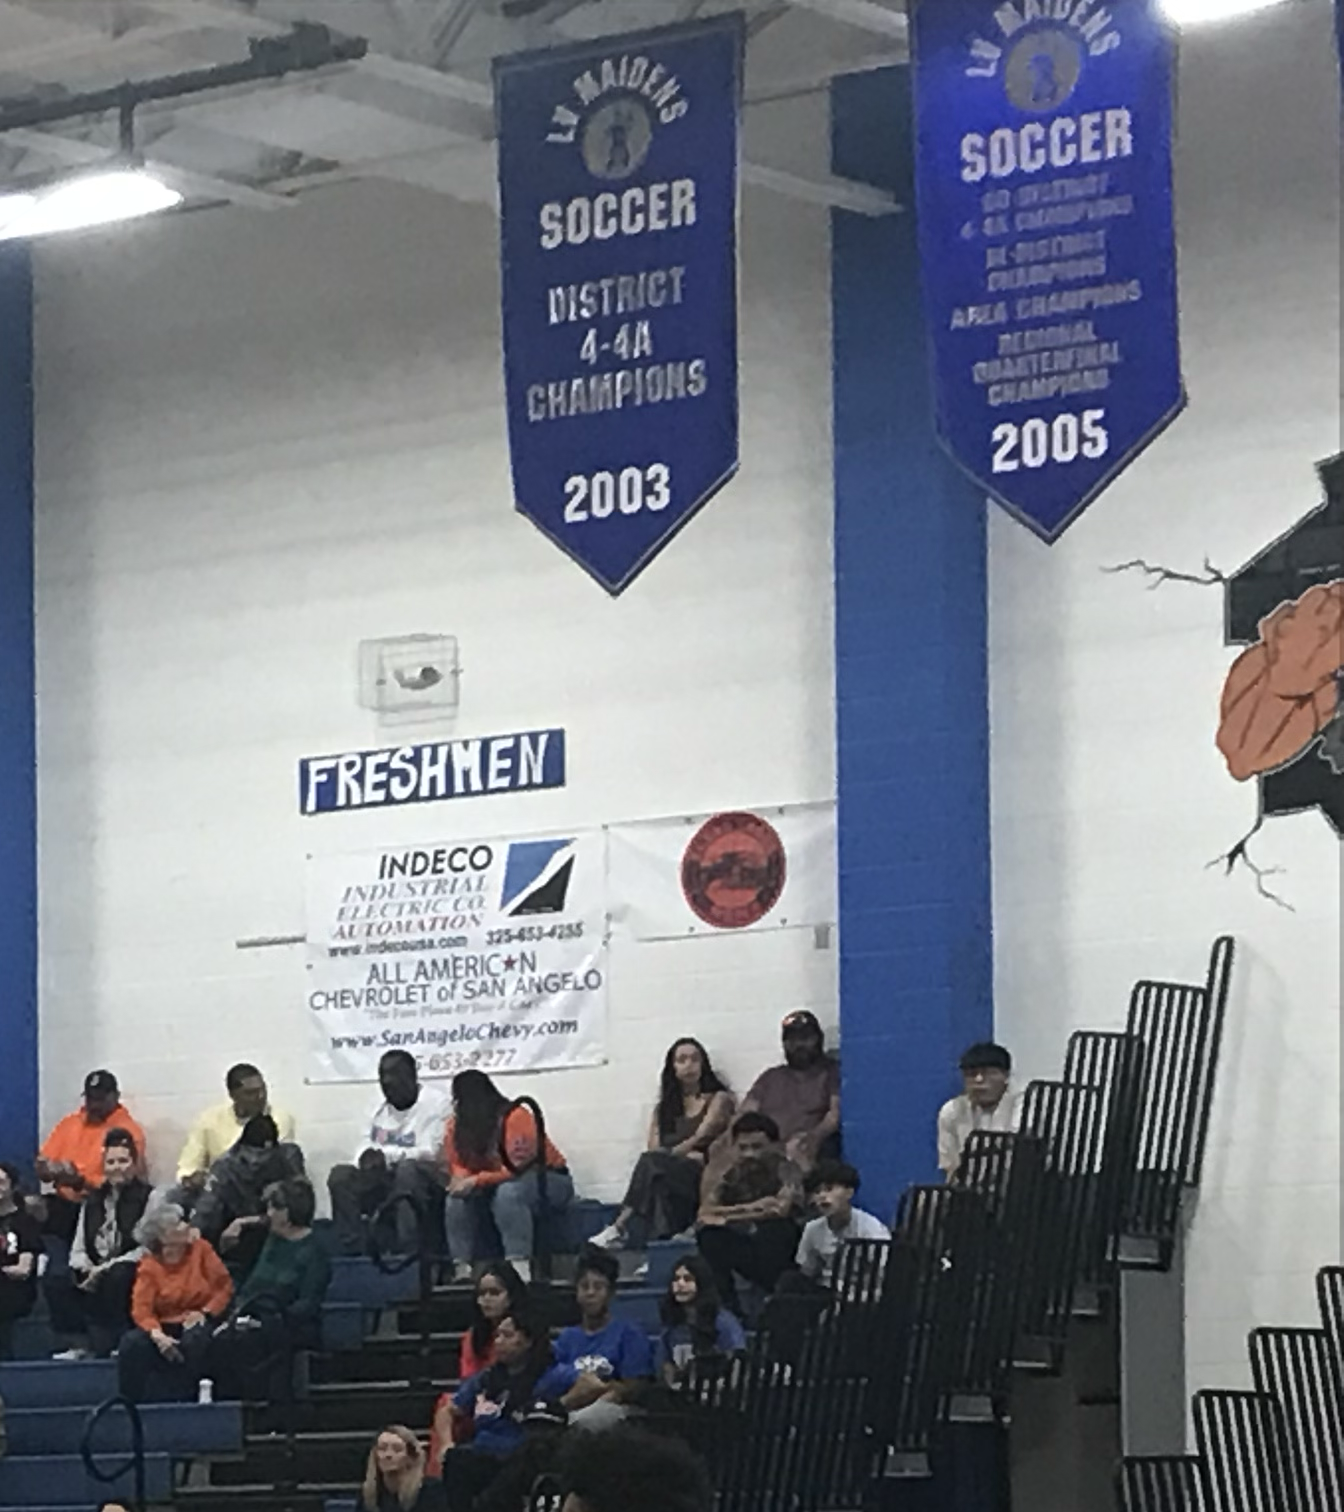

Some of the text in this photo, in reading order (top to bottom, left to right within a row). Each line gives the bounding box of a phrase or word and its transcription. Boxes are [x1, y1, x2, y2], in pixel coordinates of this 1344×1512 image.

[546, 55, 688, 145] LV MAIDENS
[959, 107, 1133, 183] SOCCER
[539, 178, 697, 250] SOCCER
[547, 267, 686, 326] DISTRICT
[579, 320, 653, 366] 4-4A
[527, 359, 708, 423] CHAMPIONS
[992, 408, 1108, 473] 2005
[563, 463, 672, 524] 2003
[306, 732, 550, 812] FRESHMEN
[342, 874, 488, 903] INDUSTRIAL
[379, 845, 493, 880] INDECO
[332, 913, 484, 941] AUTOMATION
[337, 898, 443, 922] ELECTRIC
[309, 983, 430, 1011] CHEVROLET
[437, 981, 458, 1001] of
[463, 978, 506, 998] SAN
[513, 969, 602, 995] ANGELO
[367, 962, 408, 985] ALL
[331, 1018, 578, 1050] www.SanAngeloChevy.com
